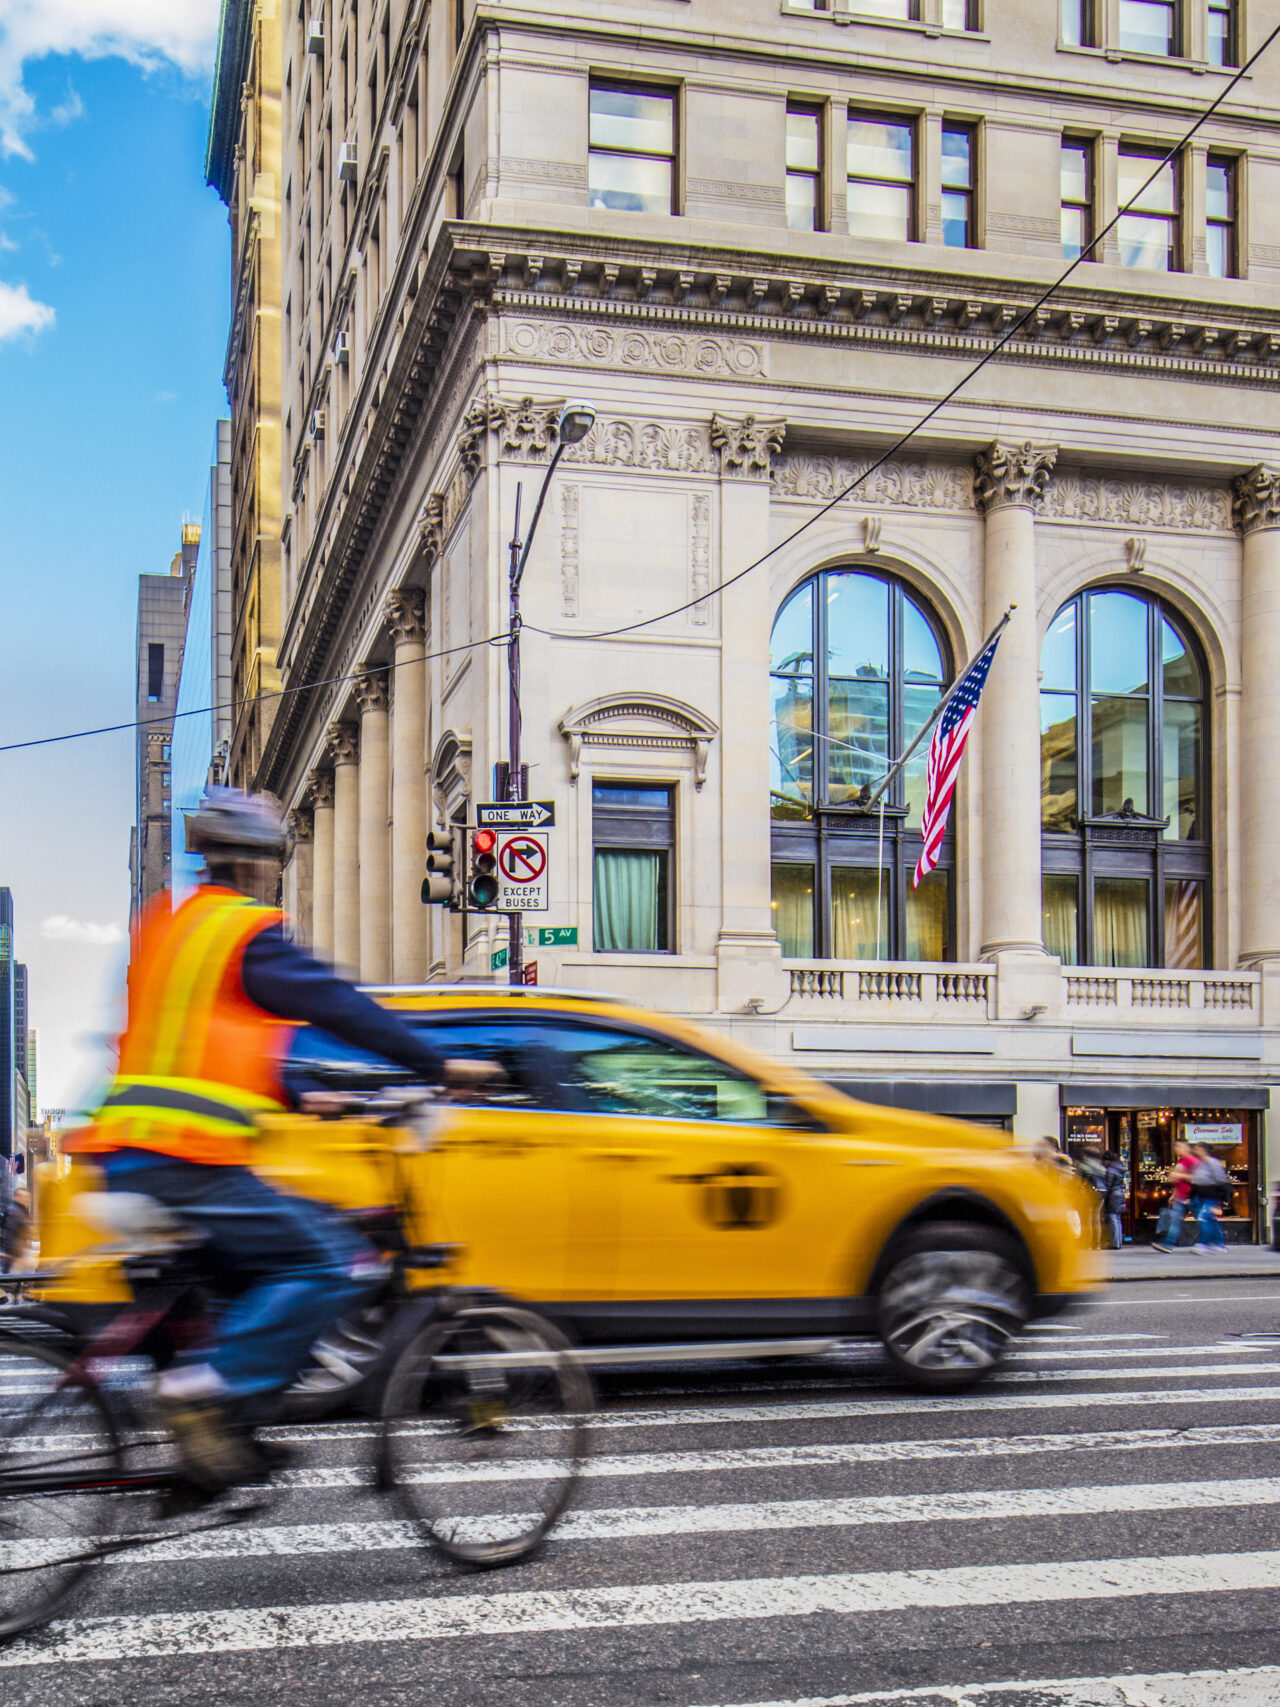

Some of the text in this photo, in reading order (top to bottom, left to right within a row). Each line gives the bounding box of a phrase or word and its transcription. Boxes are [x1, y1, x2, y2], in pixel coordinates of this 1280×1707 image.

[487, 809, 543, 821] ONE WAY
[503, 887, 541, 896] EXCEPT
[505, 898, 539, 908] BUSES
[544, 928, 572, 945] 5 AV
[1193, 1126, 1234, 1134] Clearance Sale
